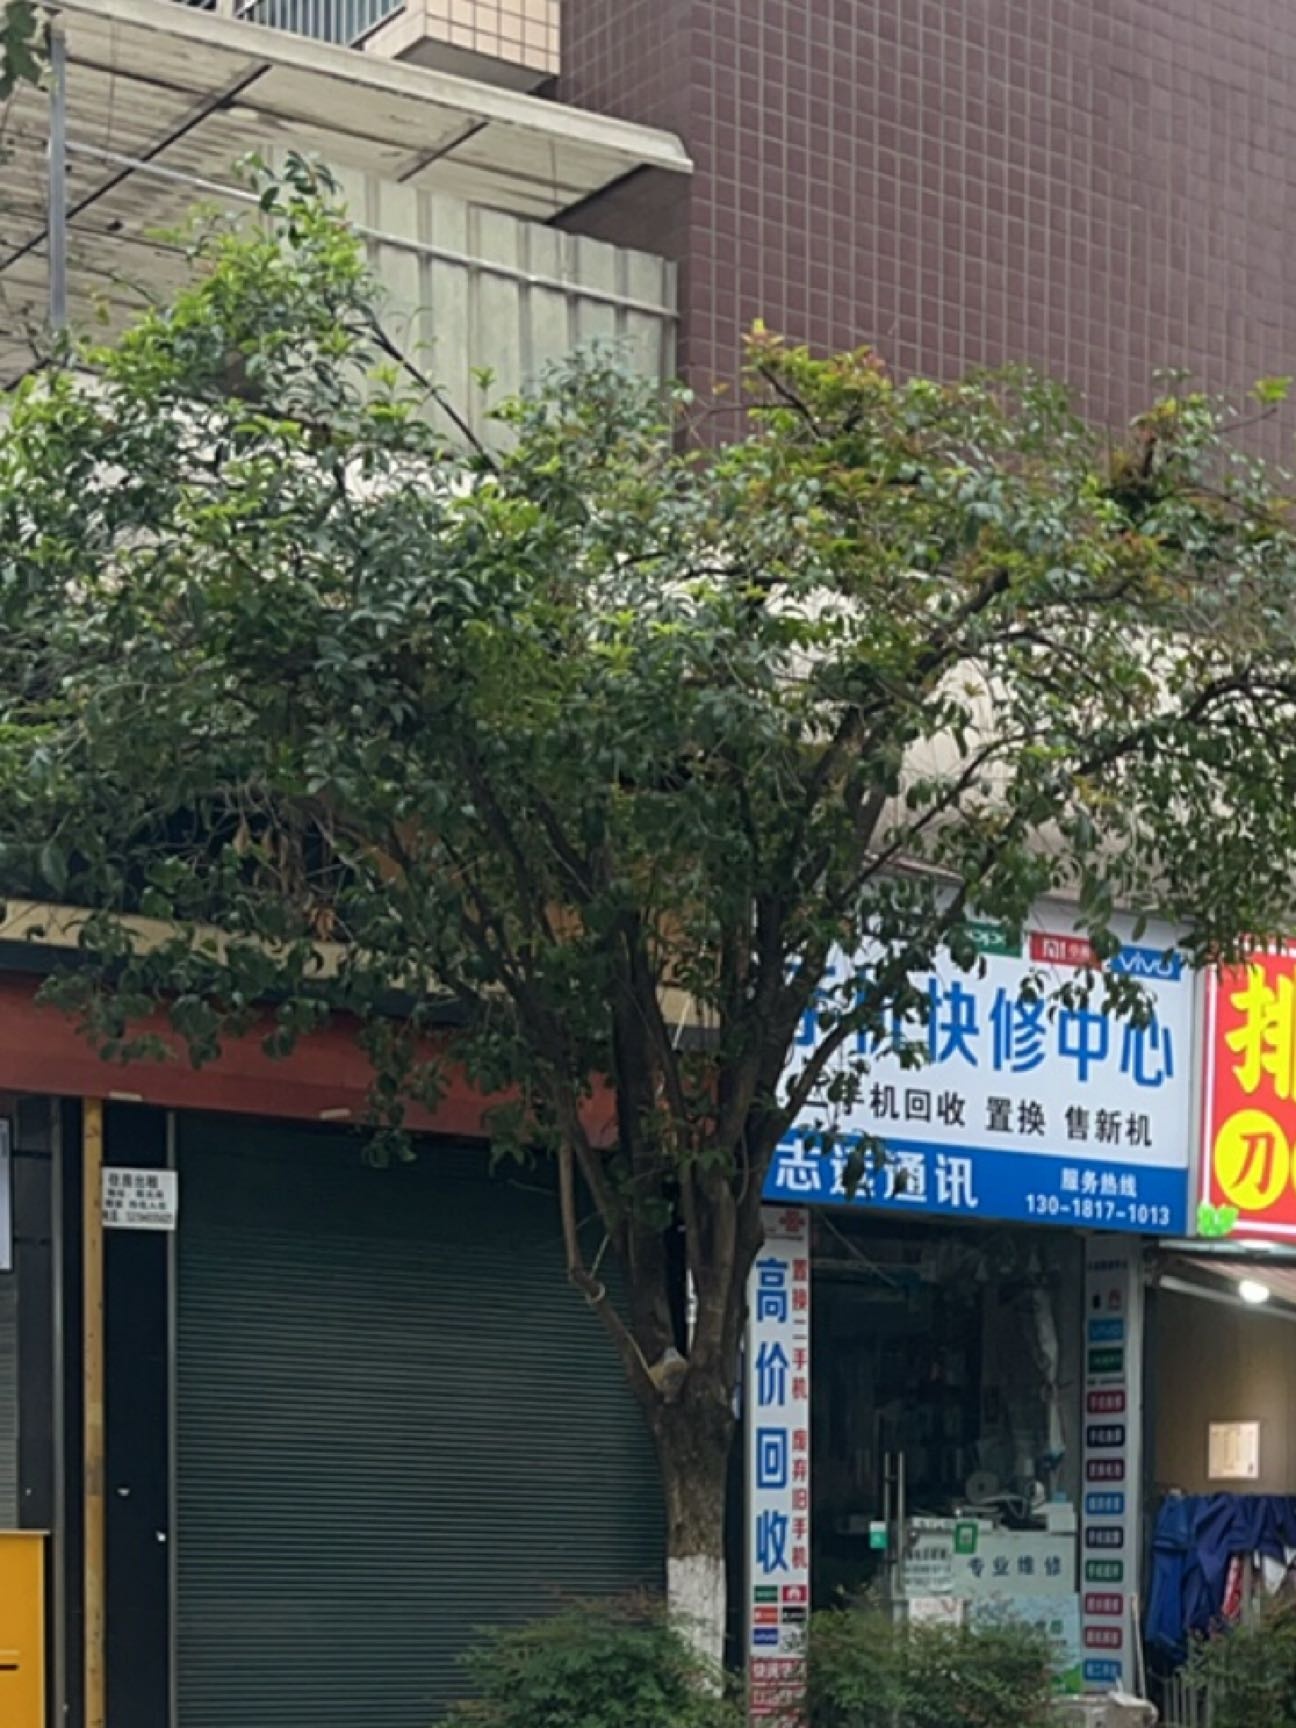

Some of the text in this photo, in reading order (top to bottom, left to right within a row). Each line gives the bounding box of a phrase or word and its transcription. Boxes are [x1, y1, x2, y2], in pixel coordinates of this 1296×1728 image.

[985, 1095, 1046, 1137] 置换
[1064, 1104, 1153, 1147] 售新机
[1060, 1167, 1137, 1197] 服务热线
[1026, 1193, 1169, 1225] 130-1817-1013
[756, 1258, 789, 1575] 高价回收
